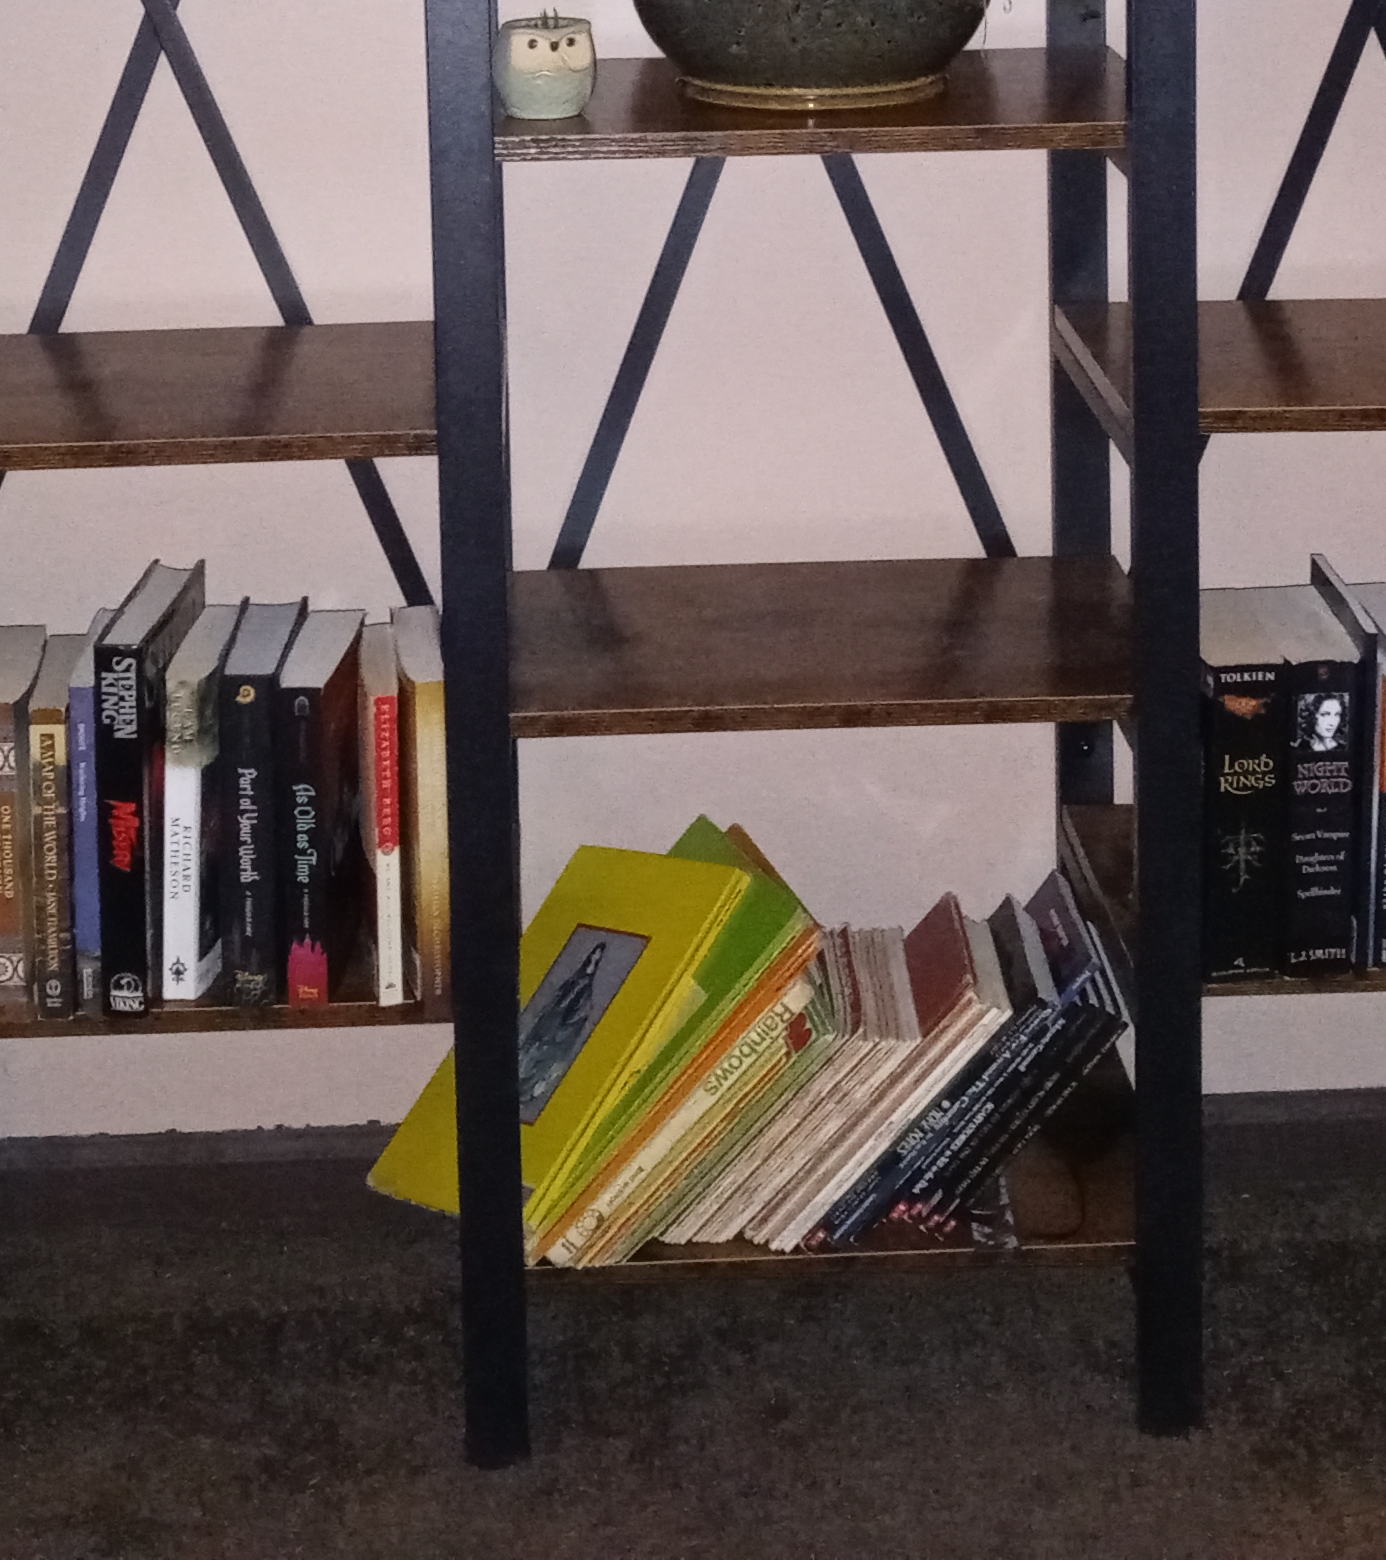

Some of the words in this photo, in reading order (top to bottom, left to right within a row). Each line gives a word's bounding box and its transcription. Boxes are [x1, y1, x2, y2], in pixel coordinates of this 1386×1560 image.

[1220, 672, 1276, 683] TOLKIEN
[100, 671, 119, 725] KING
[111, 656, 138, 740] STEPHEN
[1297, 762, 1349, 778] NIGHT
[1220, 774, 1276, 794] RINGS
[1293, 779, 1353, 795] WORLD
[703, 1001, 796, 1097] Rainbows
